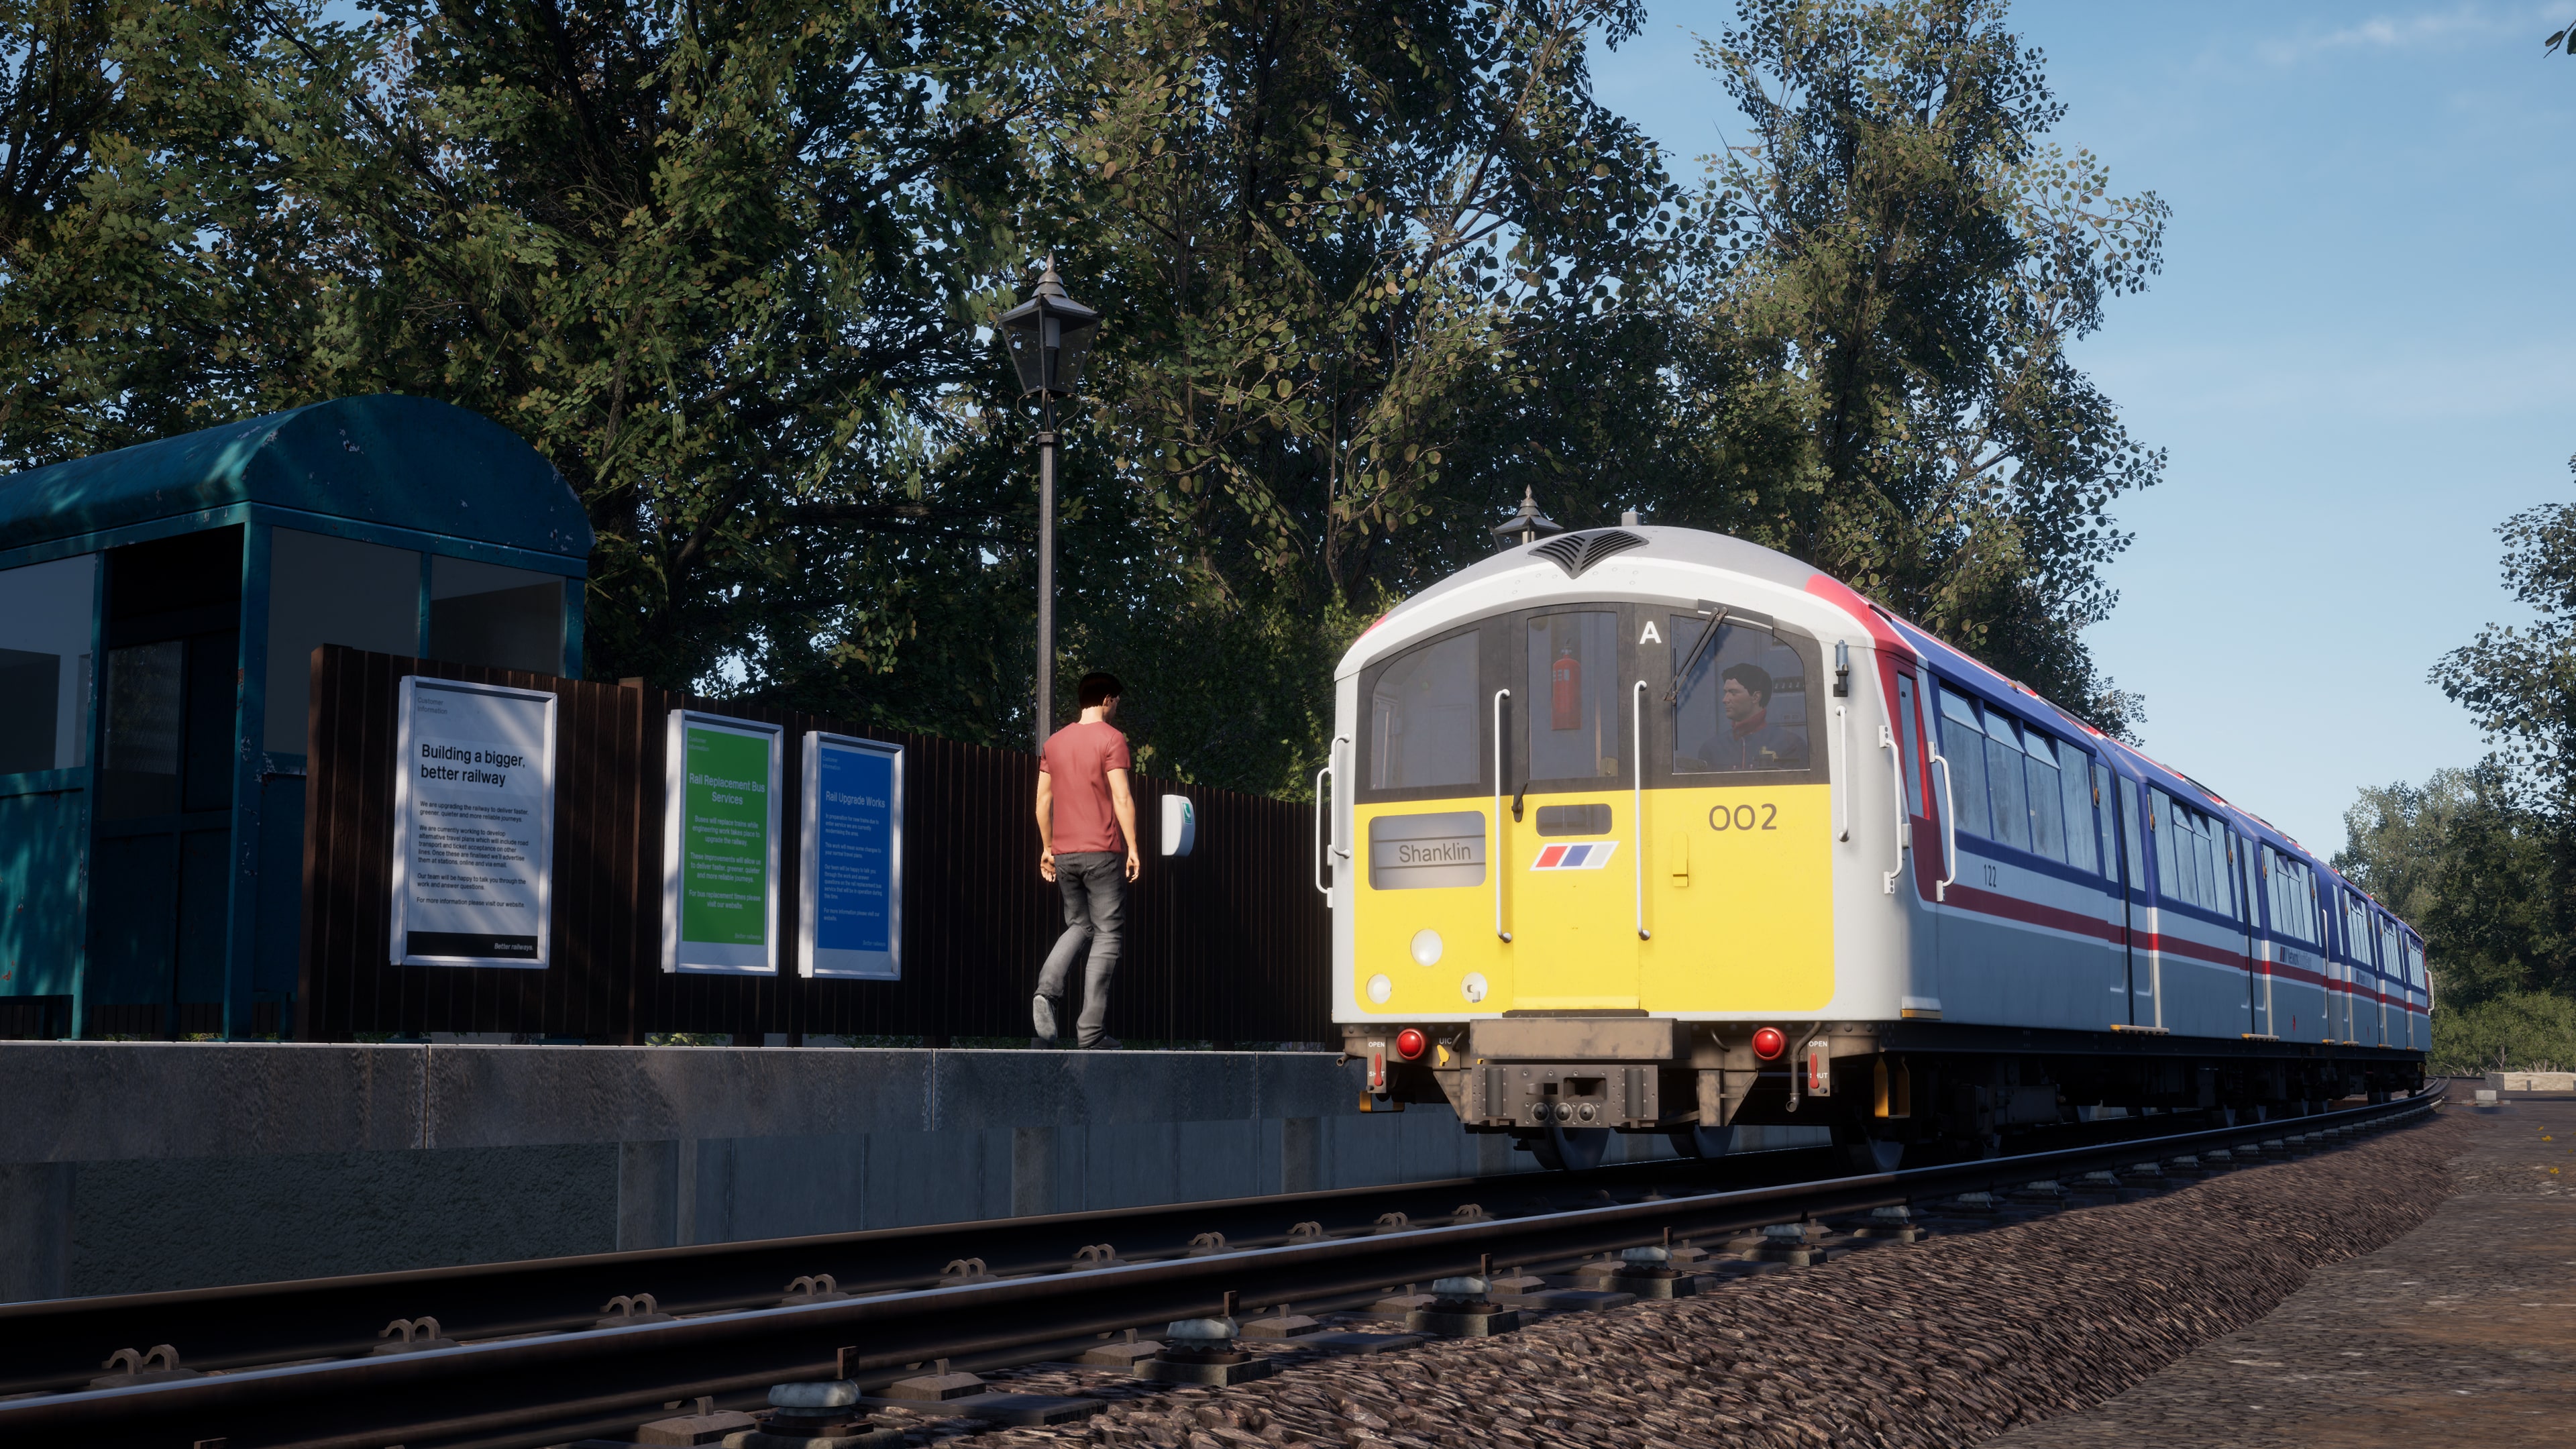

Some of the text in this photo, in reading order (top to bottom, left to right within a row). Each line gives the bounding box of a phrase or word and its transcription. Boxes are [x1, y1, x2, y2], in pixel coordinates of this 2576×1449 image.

[1640, 621, 1662, 644] A
[417, 696, 443, 706] Customer
[417, 704, 447, 714] Information
[421, 743, 525, 769] Building a bigger,
[421, 763, 506, 788] better railway
[688, 772, 765, 793] Rail Replacement Bus
[437, 802, 463, 810] upgrading
[711, 791, 743, 805] Services
[825, 790, 885, 808] Rail Upgrade Works
[441, 810, 459, 818] quieter
[1709, 803, 1777, 831] 002
[419, 833, 445, 841] alternative
[461, 835, 475, 843] plans
[460, 827, 480, 836] working
[486, 829, 506, 837] develop
[1399, 842, 1471, 863] Shanklin
[457, 875, 472, 883] happy
[1984, 864, 1996, 888] 122
